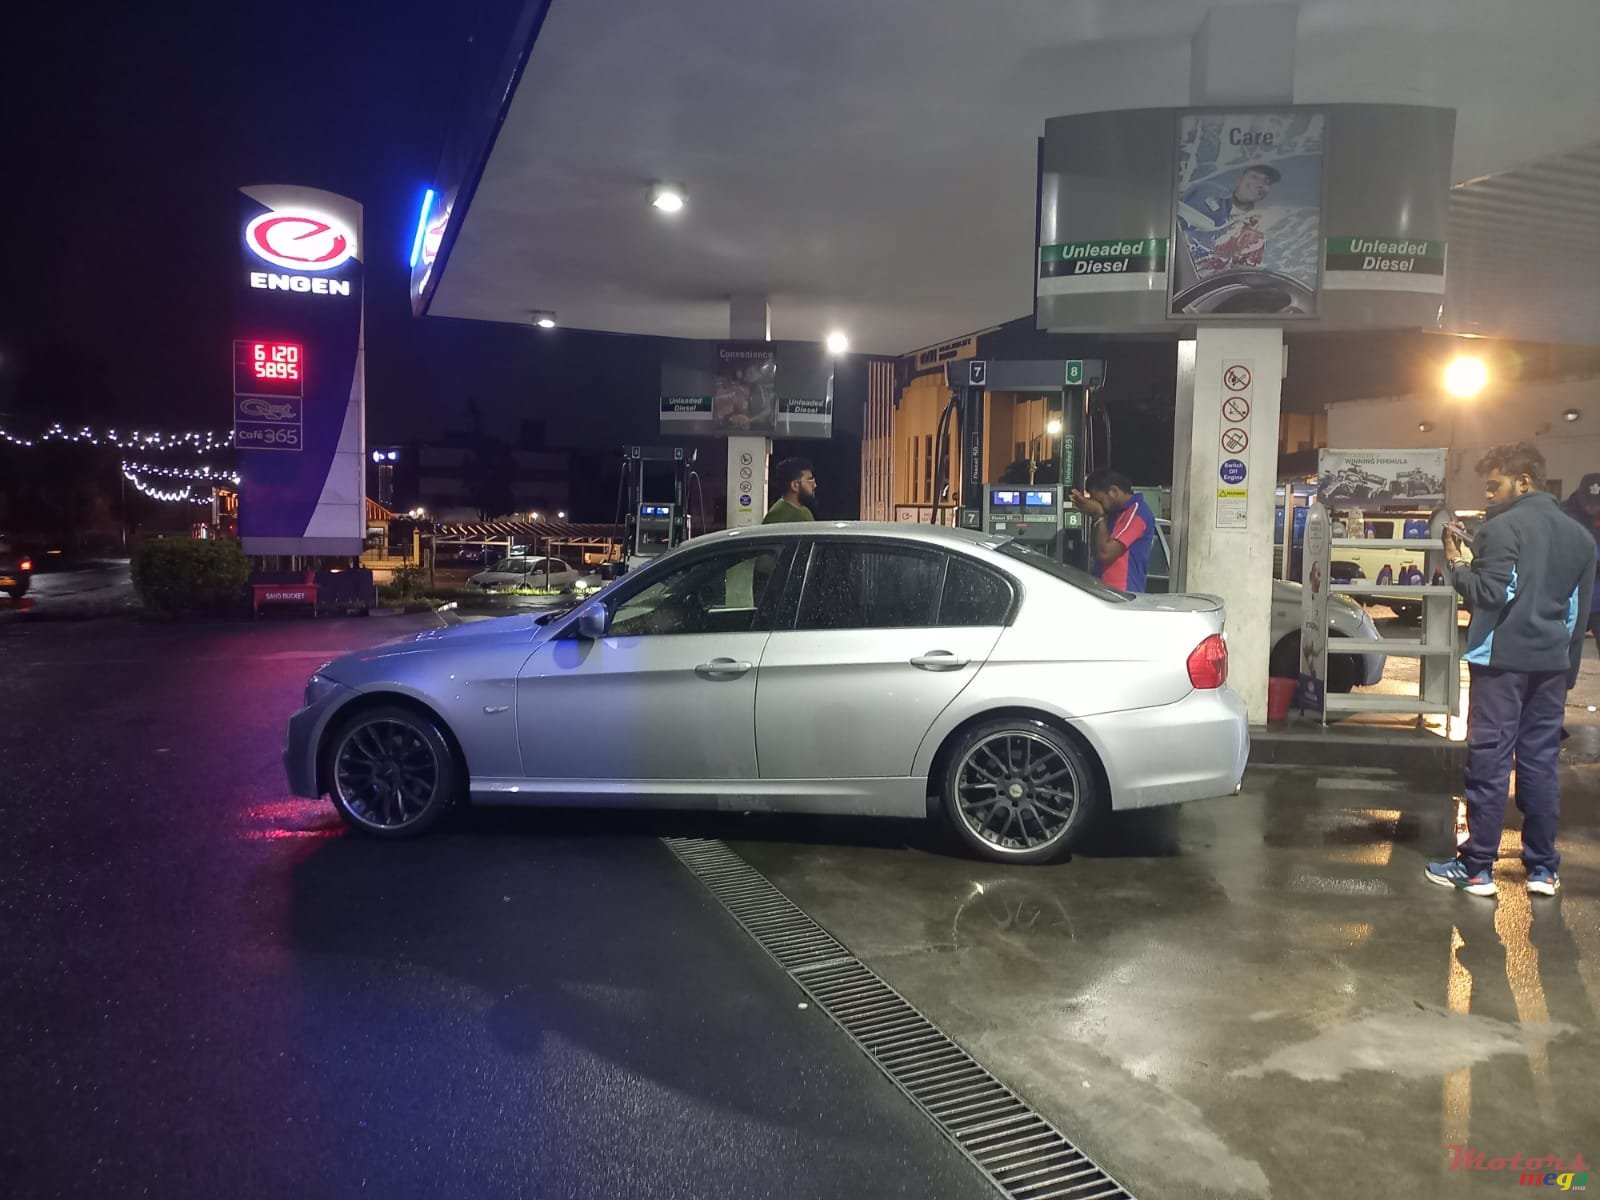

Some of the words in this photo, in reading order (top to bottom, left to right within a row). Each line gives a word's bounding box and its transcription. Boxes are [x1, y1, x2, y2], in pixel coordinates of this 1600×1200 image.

[1229, 127, 1274, 146] Care
[1062, 241, 1144, 259] Unleaded
[1350, 239, 1427, 256] Unleaded
[1074, 258, 1129, 274] Diesel
[1362, 256, 1415, 272] Diesel
[250, 272, 350, 296] ENGEN
[719, 350, 774, 360] Convenience
[973, 366, 982, 378] 7
[1070, 366, 1078, 377] 8
[669, 397, 703, 405] Unleaded
[788, 399, 824, 407] Unleaded
[674, 404, 697, 412] Diesel
[794, 406, 818, 414] Diesel
[239, 429, 264, 440] Café
[263, 428, 299, 444] 365
[1065, 438, 1074, 449] 95
[968, 513, 976, 524] 7
[1069, 515, 1078, 525] 8
